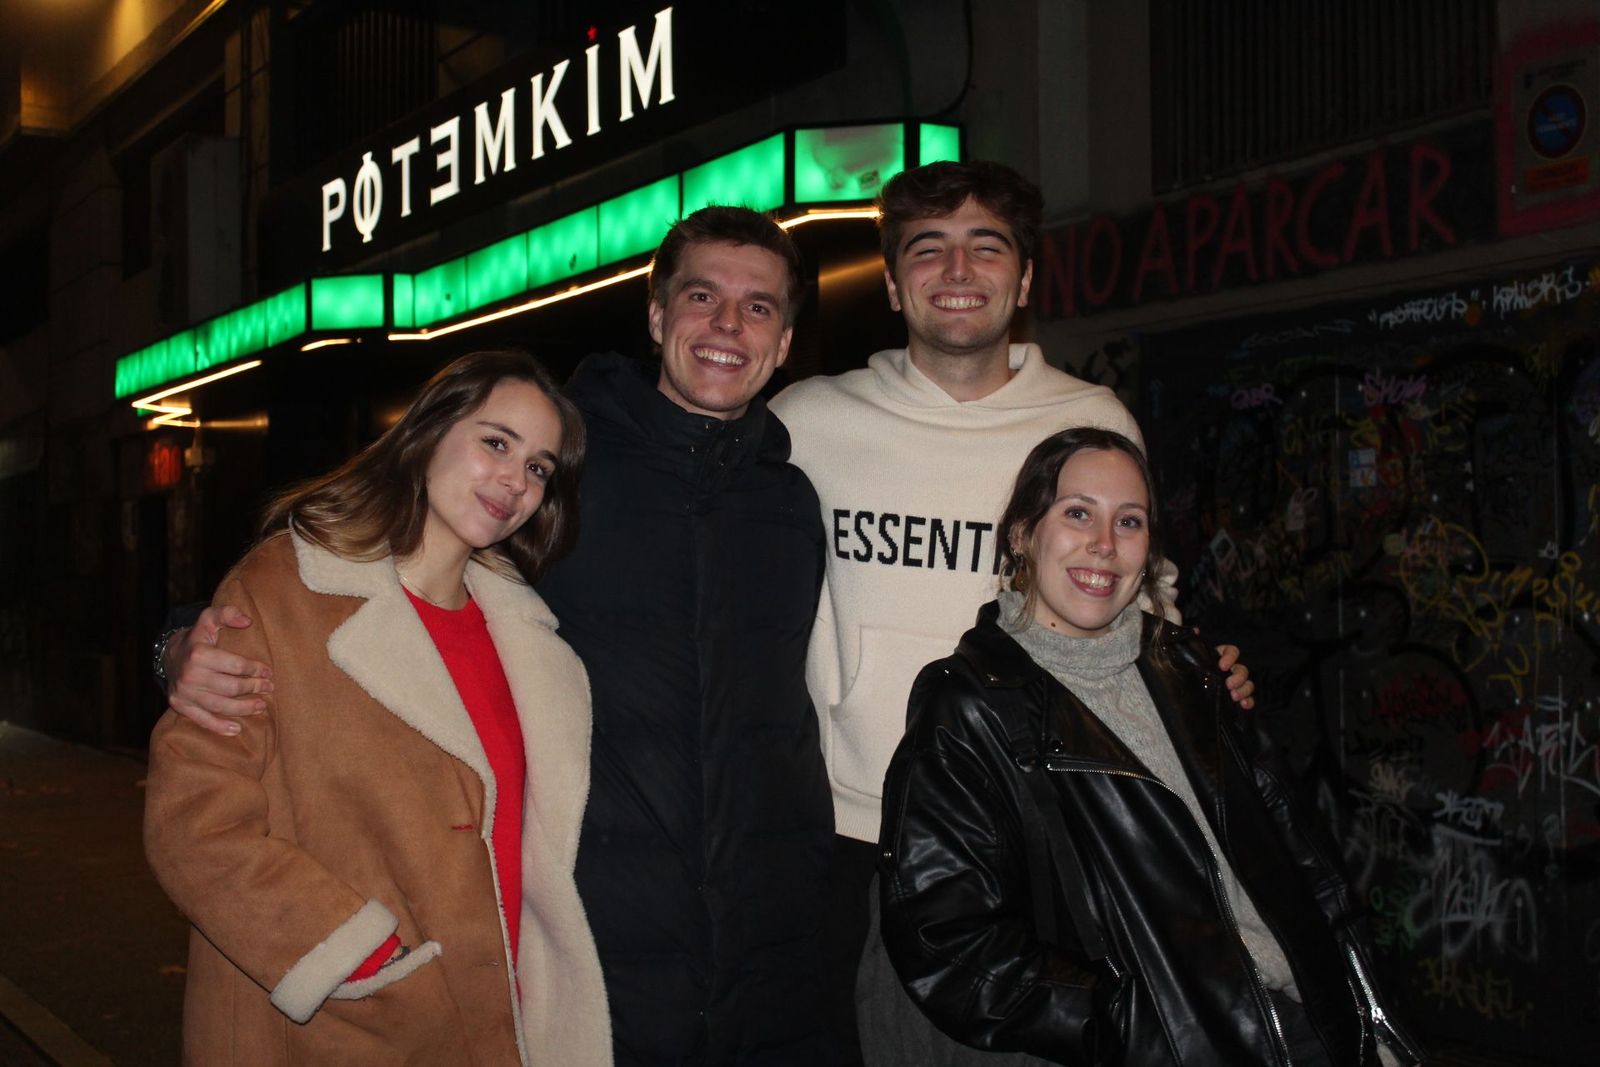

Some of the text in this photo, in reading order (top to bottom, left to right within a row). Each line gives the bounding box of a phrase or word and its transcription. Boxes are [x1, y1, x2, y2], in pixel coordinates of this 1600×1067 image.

[1040, 214, 1123, 318] NO
[1131, 143, 1457, 303] APARCAR
[833, 508, 1013, 577] ESSENTI
